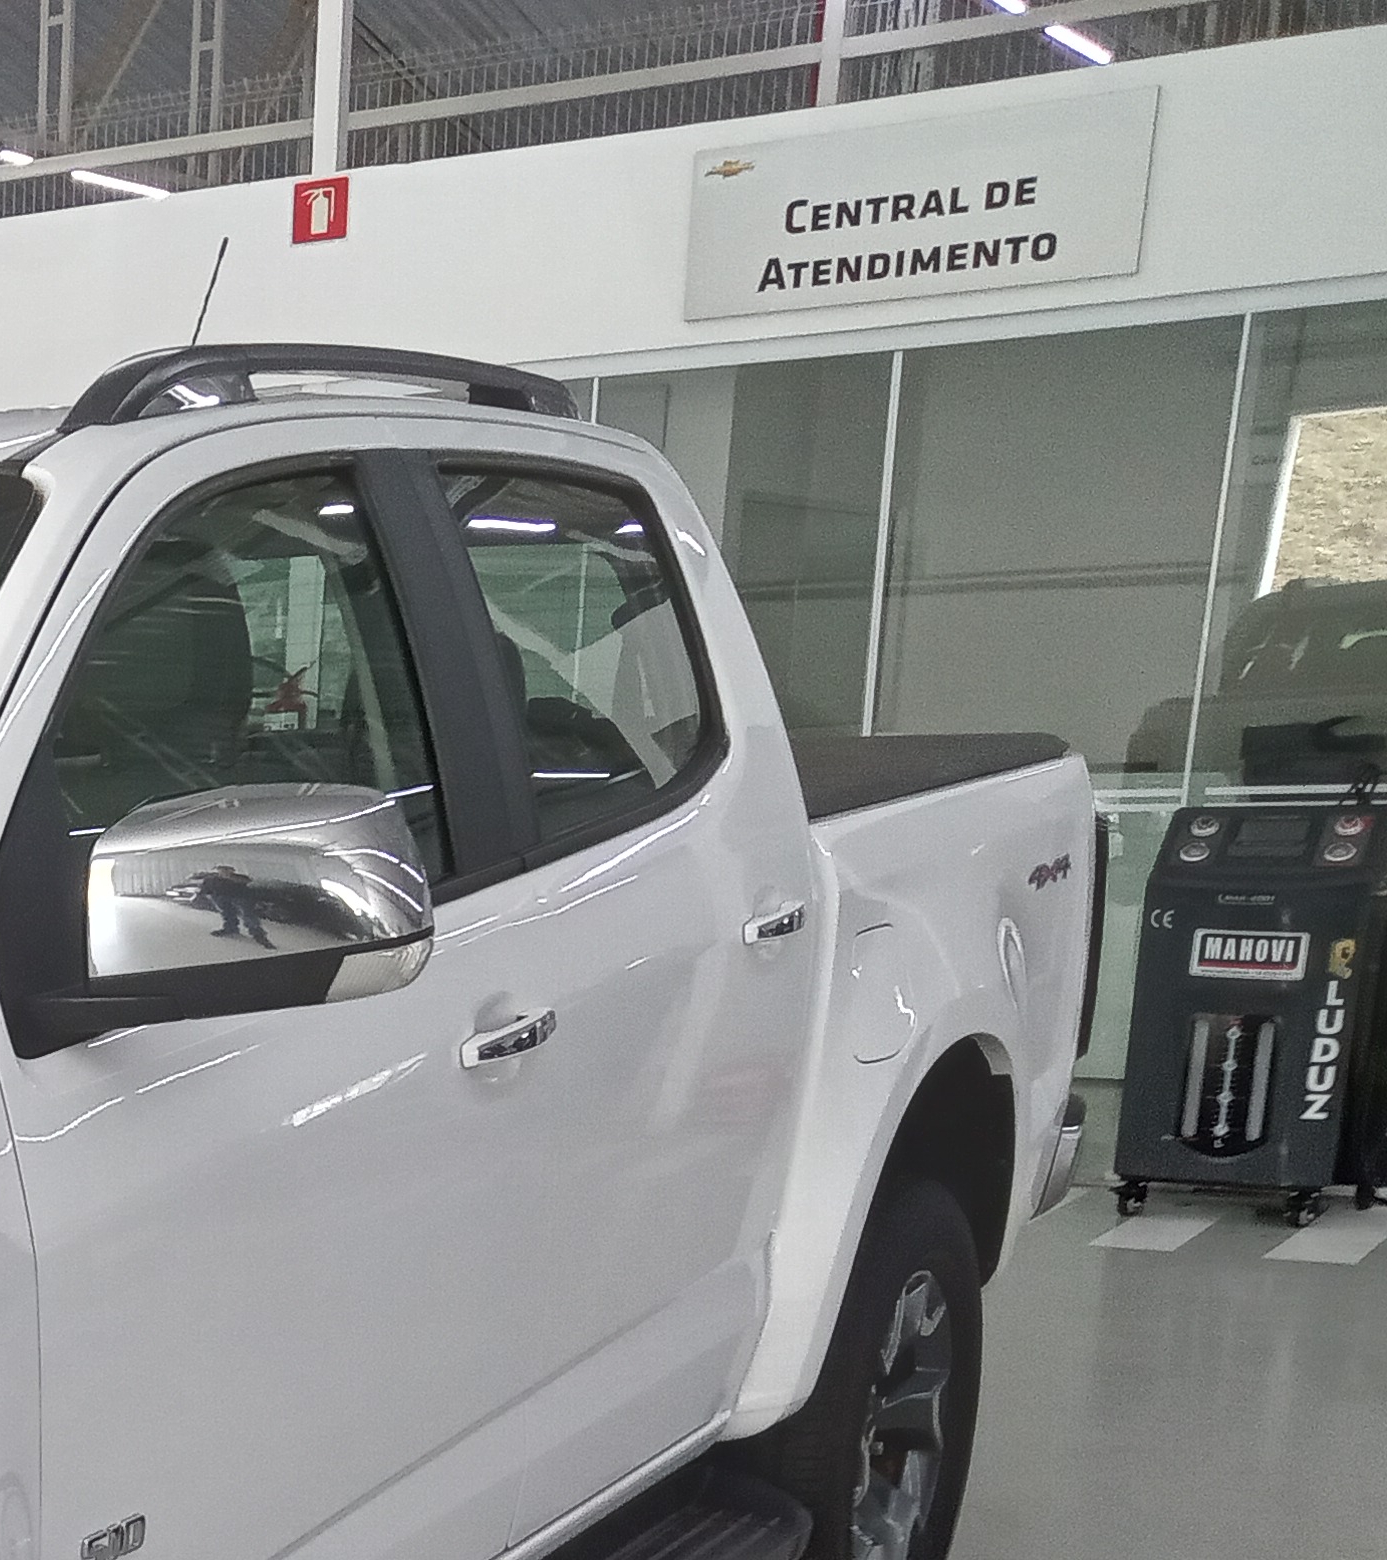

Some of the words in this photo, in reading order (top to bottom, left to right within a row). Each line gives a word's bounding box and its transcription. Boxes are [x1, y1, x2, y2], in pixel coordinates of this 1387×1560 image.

[785, 186, 969, 234] CENTRAL
[984, 176, 1038, 210] DE
[757, 231, 1057, 293] ATENDIMENTO
[1150, 908, 1175, 929] CE
[1203, 936, 1295, 963] MAHOVI
